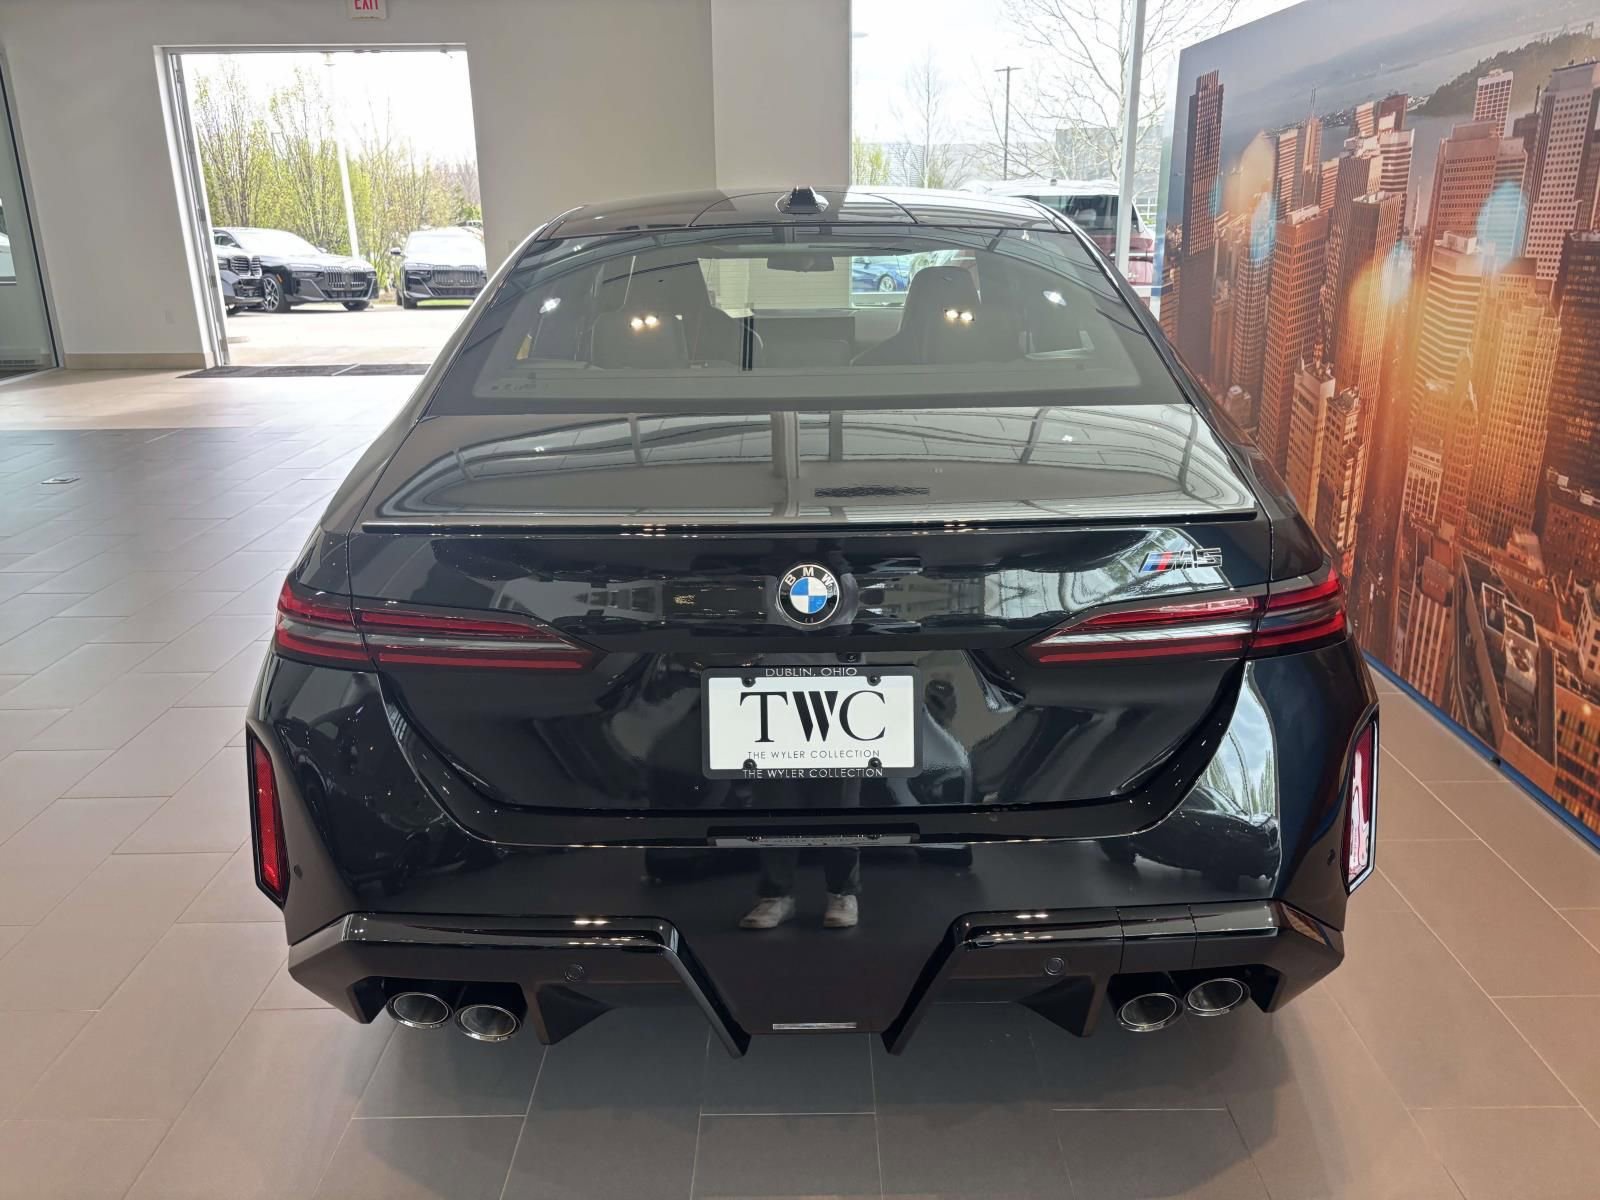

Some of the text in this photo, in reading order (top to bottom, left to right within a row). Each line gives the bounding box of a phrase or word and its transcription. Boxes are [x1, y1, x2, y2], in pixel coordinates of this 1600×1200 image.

[1160, 548, 1222, 570] M5
[785, 566, 833, 587] BMW
[821, 667, 857, 676] OHIO
[740, 690, 886, 743] TWC
[748, 749, 880, 760] THE WYLER COLLECTION
[743, 768, 883, 779] THE WYLER COLLECTION
